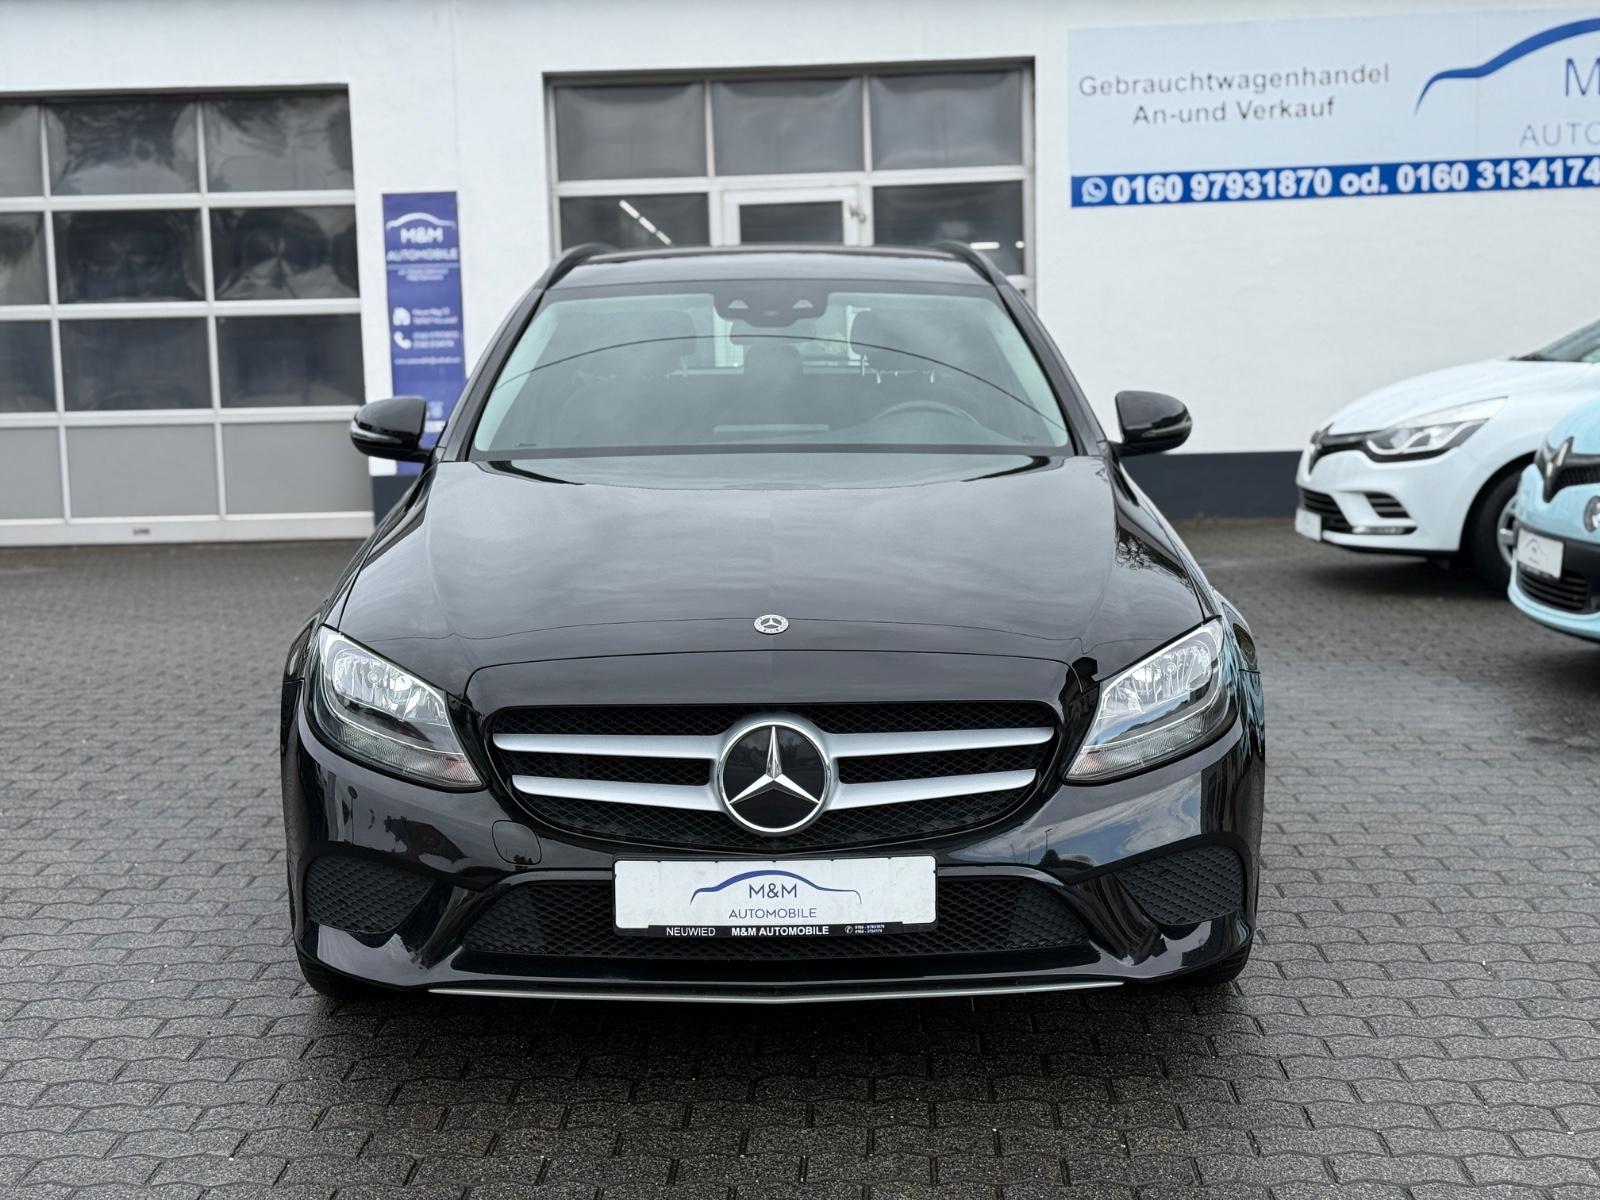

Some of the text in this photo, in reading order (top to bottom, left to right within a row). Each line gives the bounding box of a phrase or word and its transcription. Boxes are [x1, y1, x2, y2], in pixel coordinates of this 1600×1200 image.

[1079, 63, 1390, 96] Gebrauchtwagenhandel
[1133, 96, 1336, 126] An-und Verkauf
[1112, 156, 1600, 204] 0160 97931870 od. 0160 3134174
[400, 226, 444, 244] M&M
[386, 247, 459, 262] AUTOMOBILE
[748, 882, 797, 899] M&M
[728, 908, 817, 919] AUTOMOBILE
[666, 925, 830, 936] NEUWIED M&M AUTOMOBILE
